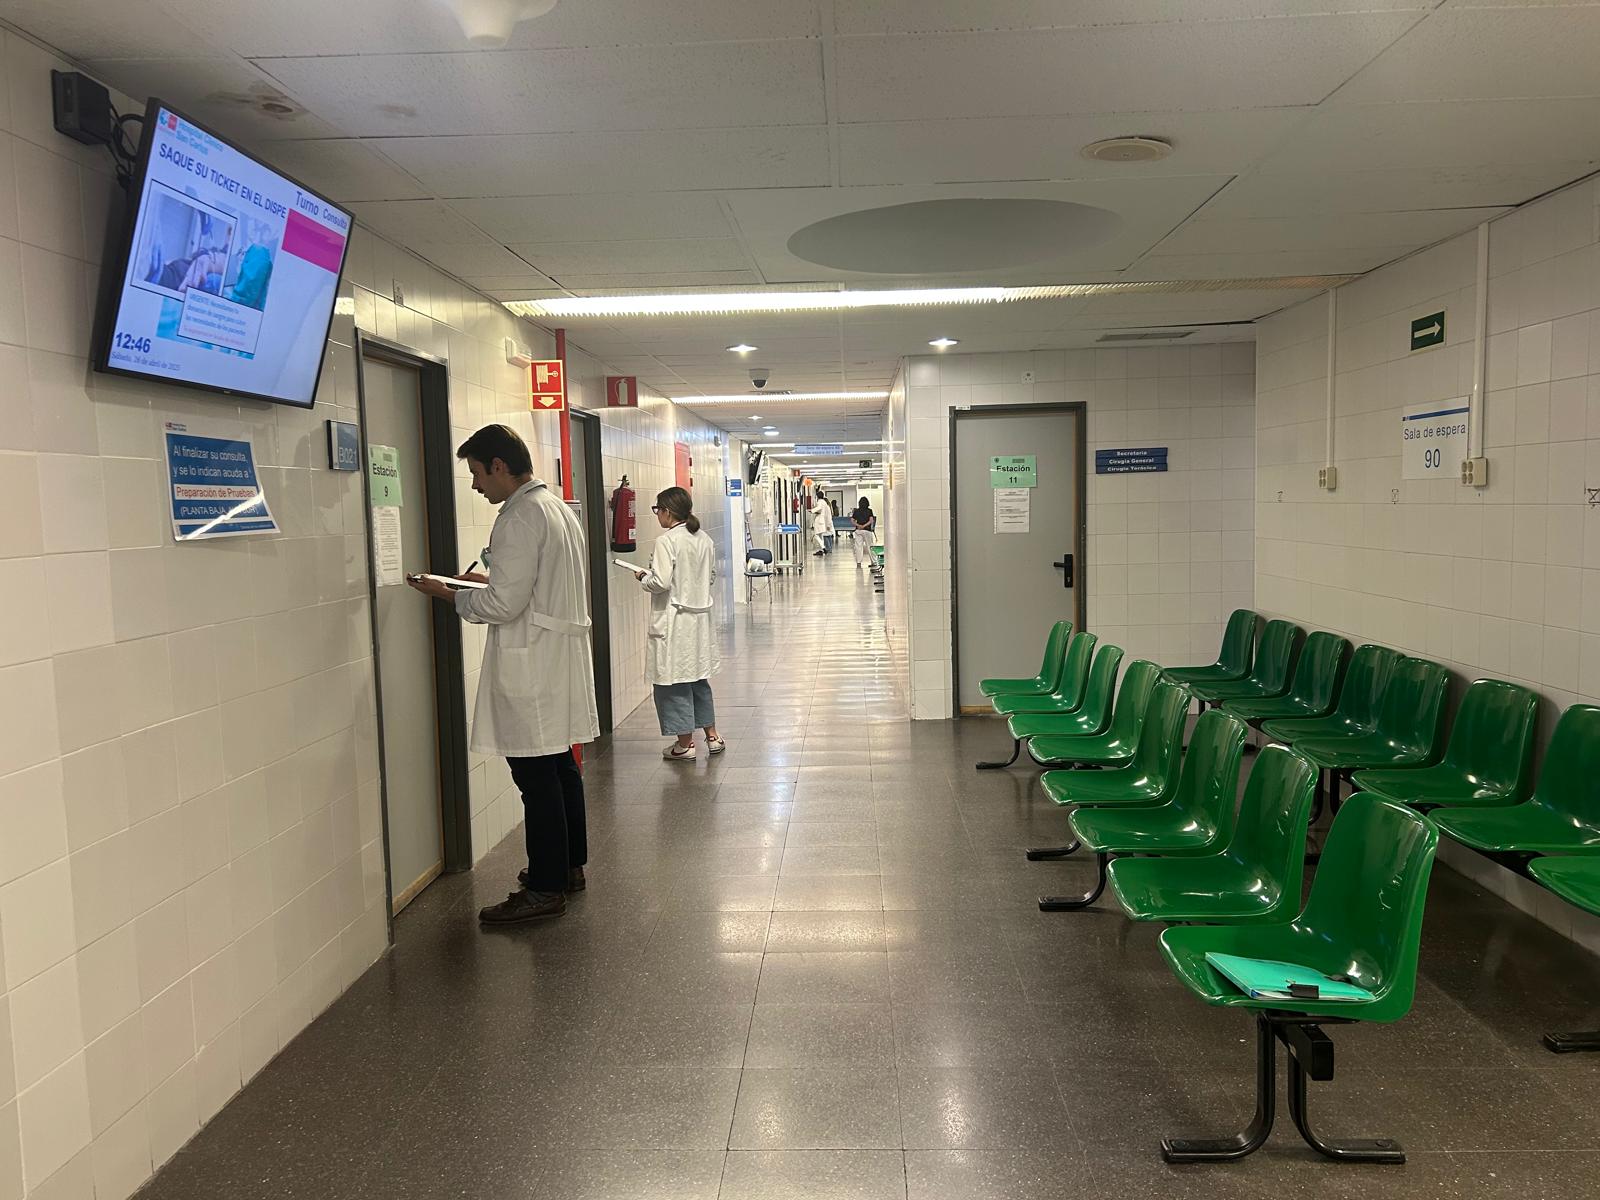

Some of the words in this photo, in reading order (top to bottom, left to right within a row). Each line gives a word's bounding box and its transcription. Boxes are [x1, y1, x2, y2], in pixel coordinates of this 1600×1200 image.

[160, 143, 194, 171] SAQUE
[195, 162, 208, 178] SU
[210, 168, 241, 194] TICKET
[241, 186, 252, 201] EN
[253, 192, 263, 207] EL
[264, 198, 287, 219] DISPE
[296, 191, 319, 215] Turno
[115, 332, 152, 353] 12:46
[1404, 428, 1421, 440] Sala
[1423, 426, 1433, 438] de
[1436, 424, 1466, 439] espera
[173, 445, 181, 456] Al
[182, 446, 209, 458] finalizar
[210, 450, 219, 459] su
[1424, 448, 1441, 469] 90
[173, 466, 178, 478] y
[179, 466, 189, 475] se
[189, 465, 196, 476] lo
[197, 466, 222, 477] indican
[223, 468, 243, 478] acuda
[243, 470, 249, 478] a
[373, 463, 397, 478] Estación
[996, 464, 1031, 472] Estación
[176, 486, 217, 499] Preparación
[219, 488, 226, 498] de
[384, 486, 389, 497] 9
[180, 506, 208, 517] (PLANTA
